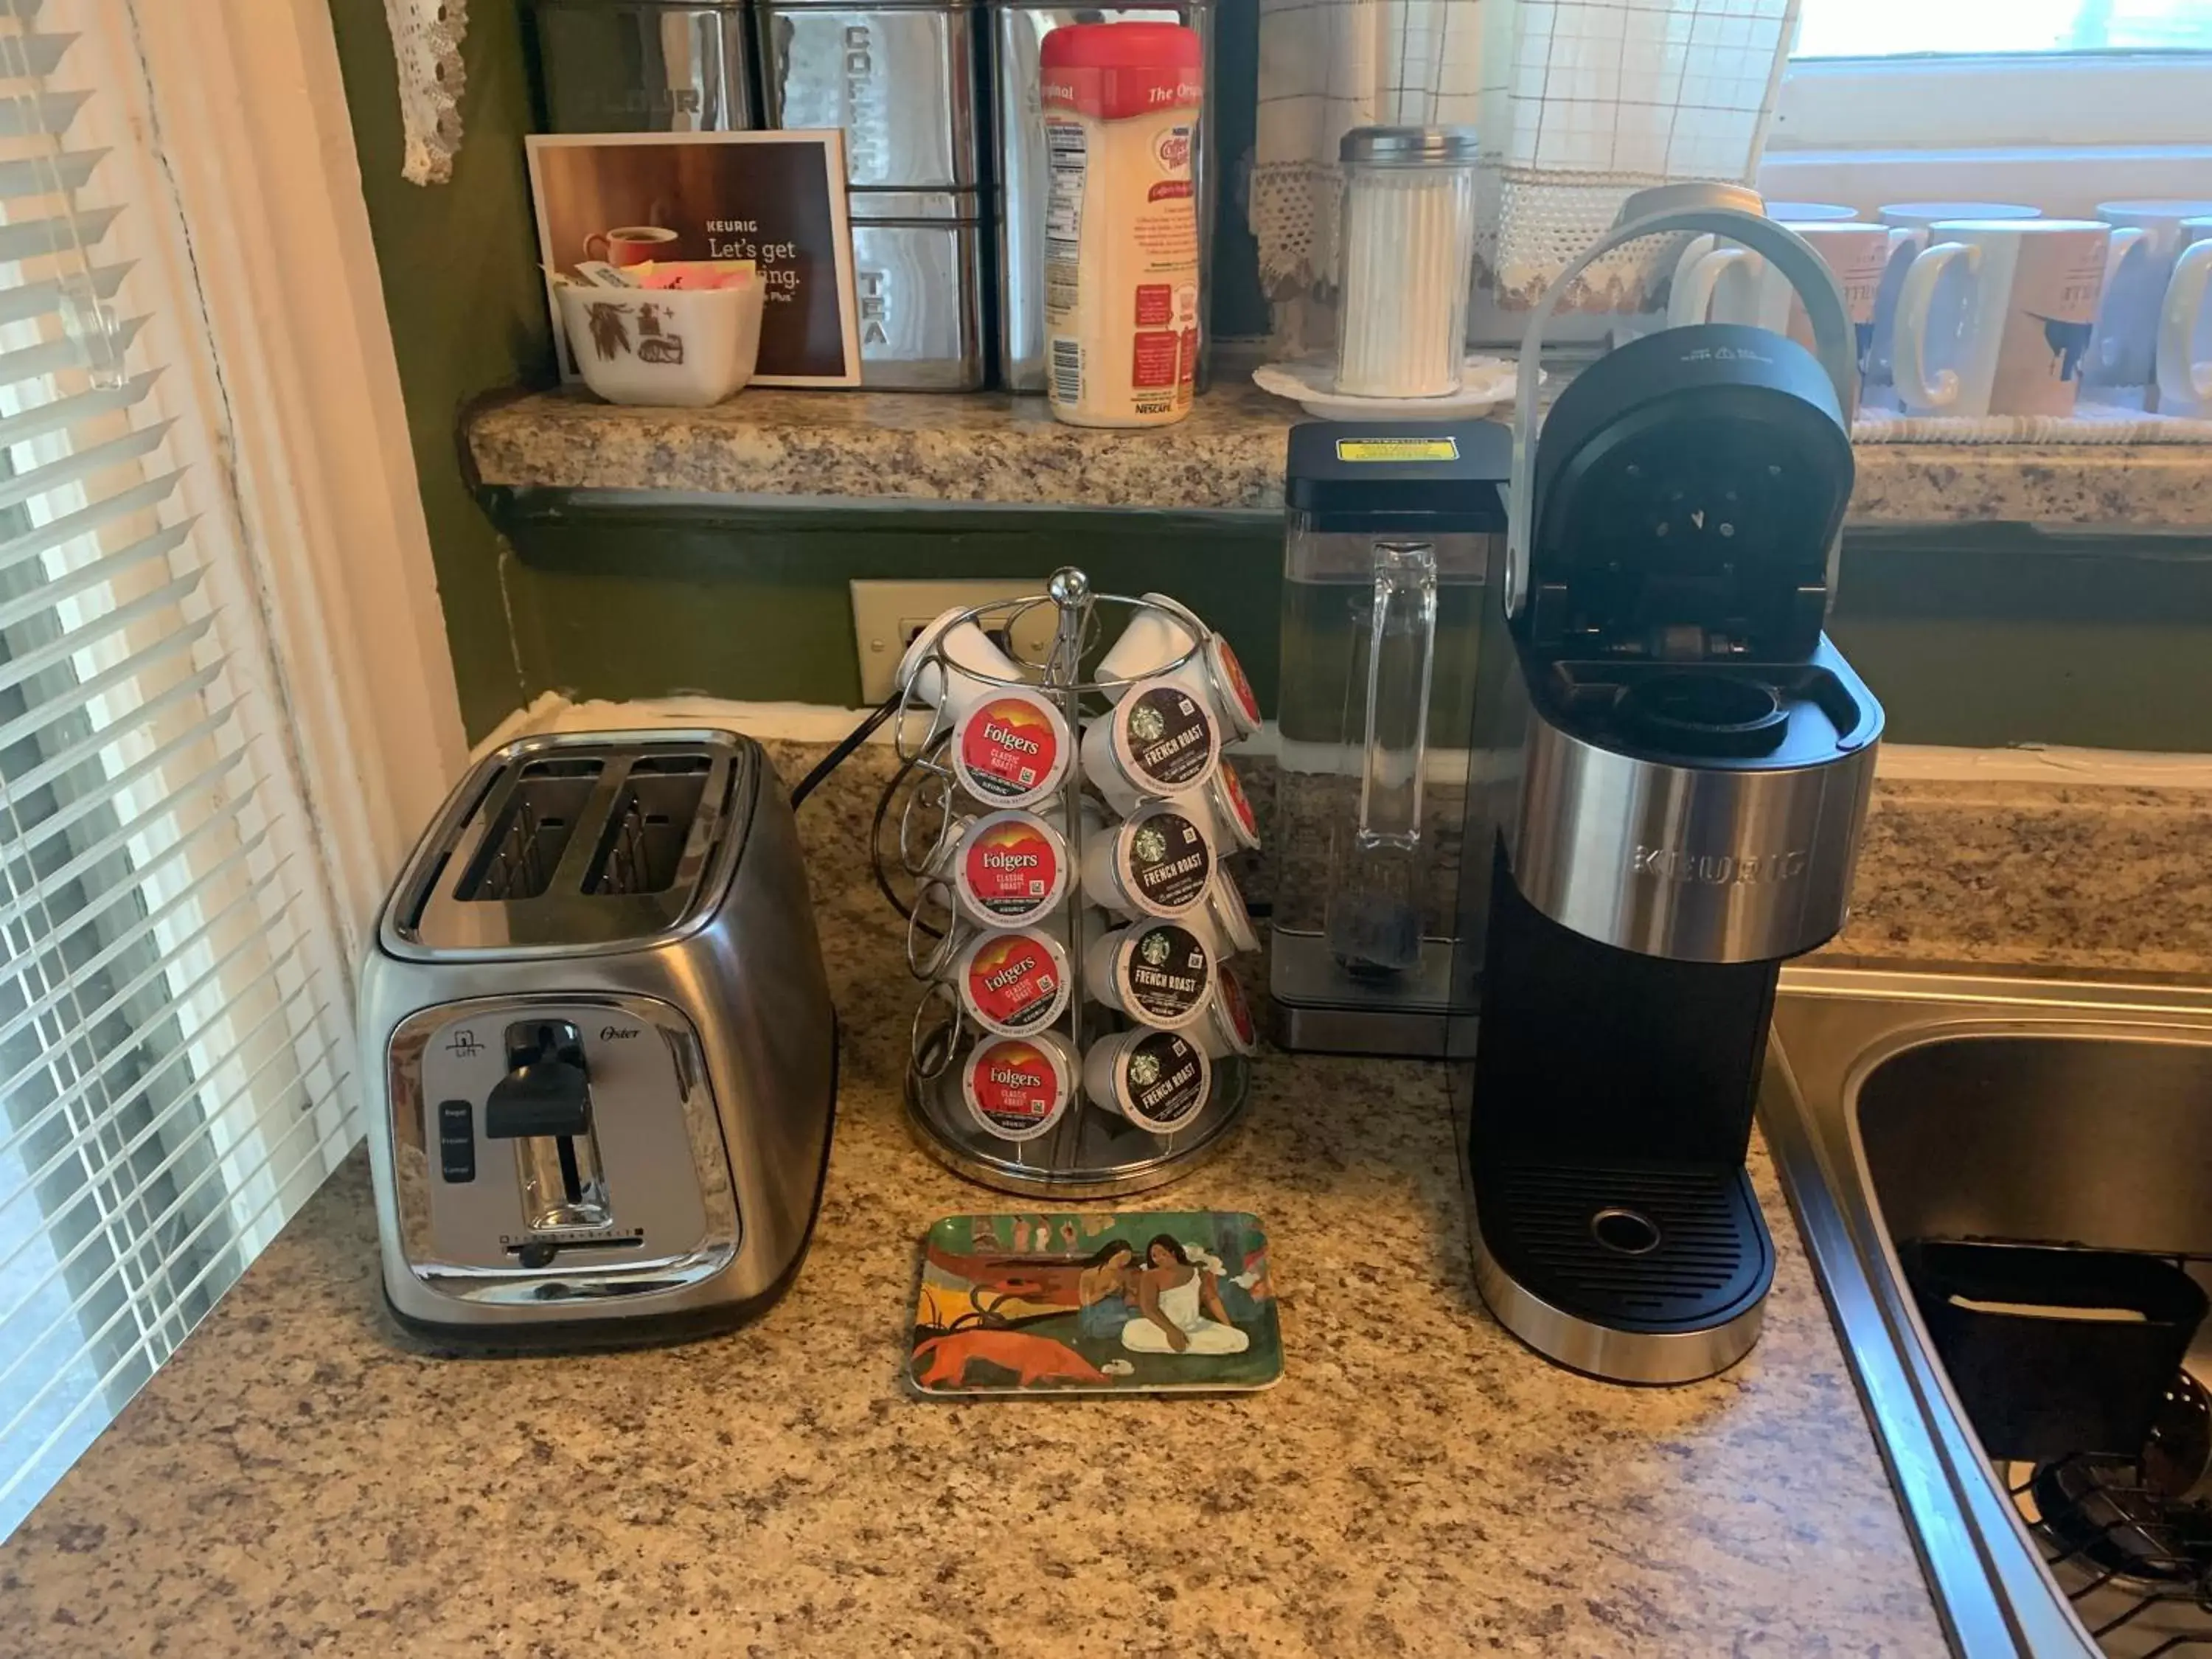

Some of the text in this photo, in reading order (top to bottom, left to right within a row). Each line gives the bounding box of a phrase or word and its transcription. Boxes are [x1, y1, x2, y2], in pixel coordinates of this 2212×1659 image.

[1149, 87, 1172, 102] The
[706, 220, 758, 232] KEURIG
[709, 238, 796, 263] Let's get
[860, 271, 887, 344] TEA
[983, 722, 1040, 755] Folgers
[1144, 738, 1180, 767] FRENCH
[1178, 723, 1204, 749] ROAST
[983, 852, 1038, 872] Folgers
[1144, 863, 1178, 888] FRENCH
[1178, 852, 1203, 874] ROAST
[1633, 845, 1806, 886] KEURIG
[984, 956, 1036, 992] Folgers
[1135, 970, 1197, 993] FRENCH ROAST
[600, 1026, 641, 1041] Oster
[456, 1048, 477, 1057] Lift
[990, 1066, 1041, 1089] Folgers
[1142, 1079, 1174, 1110] FRENCH
[1172, 1062, 1195, 1088] ROAST
